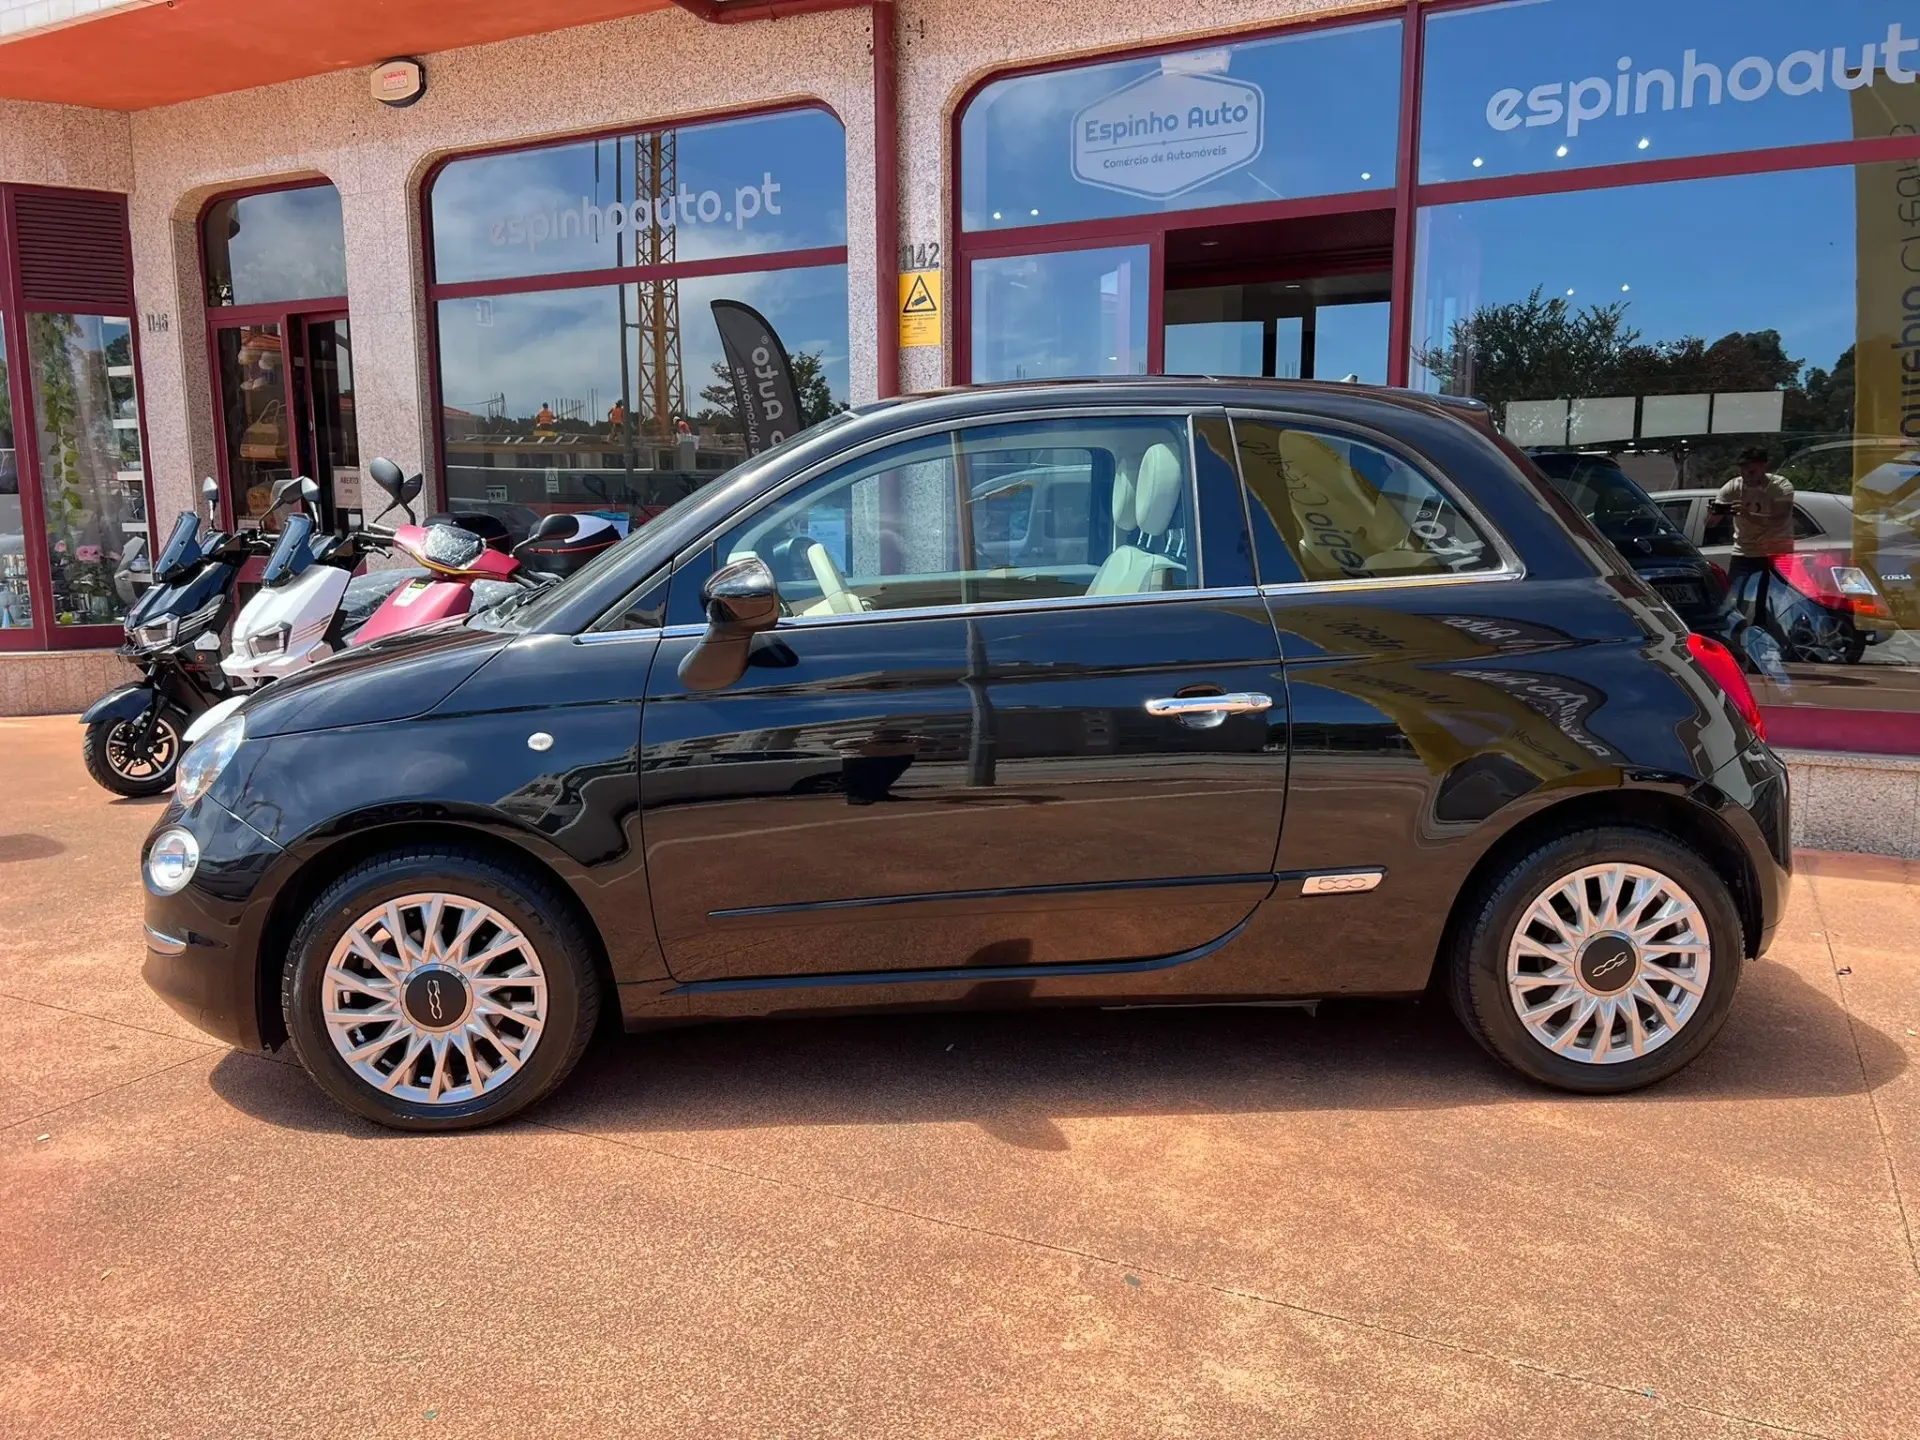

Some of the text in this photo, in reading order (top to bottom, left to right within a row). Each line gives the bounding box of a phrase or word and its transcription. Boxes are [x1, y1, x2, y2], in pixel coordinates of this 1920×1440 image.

[1085, 102, 1248, 144] Espinho Auto
[1103, 145, 1227, 169] Comércio de Automóveis
[490, 172, 781, 251] espinhoauto.pt
[901, 243, 940, 270] 1142
[1881, 573, 1912, 581] CORSA
